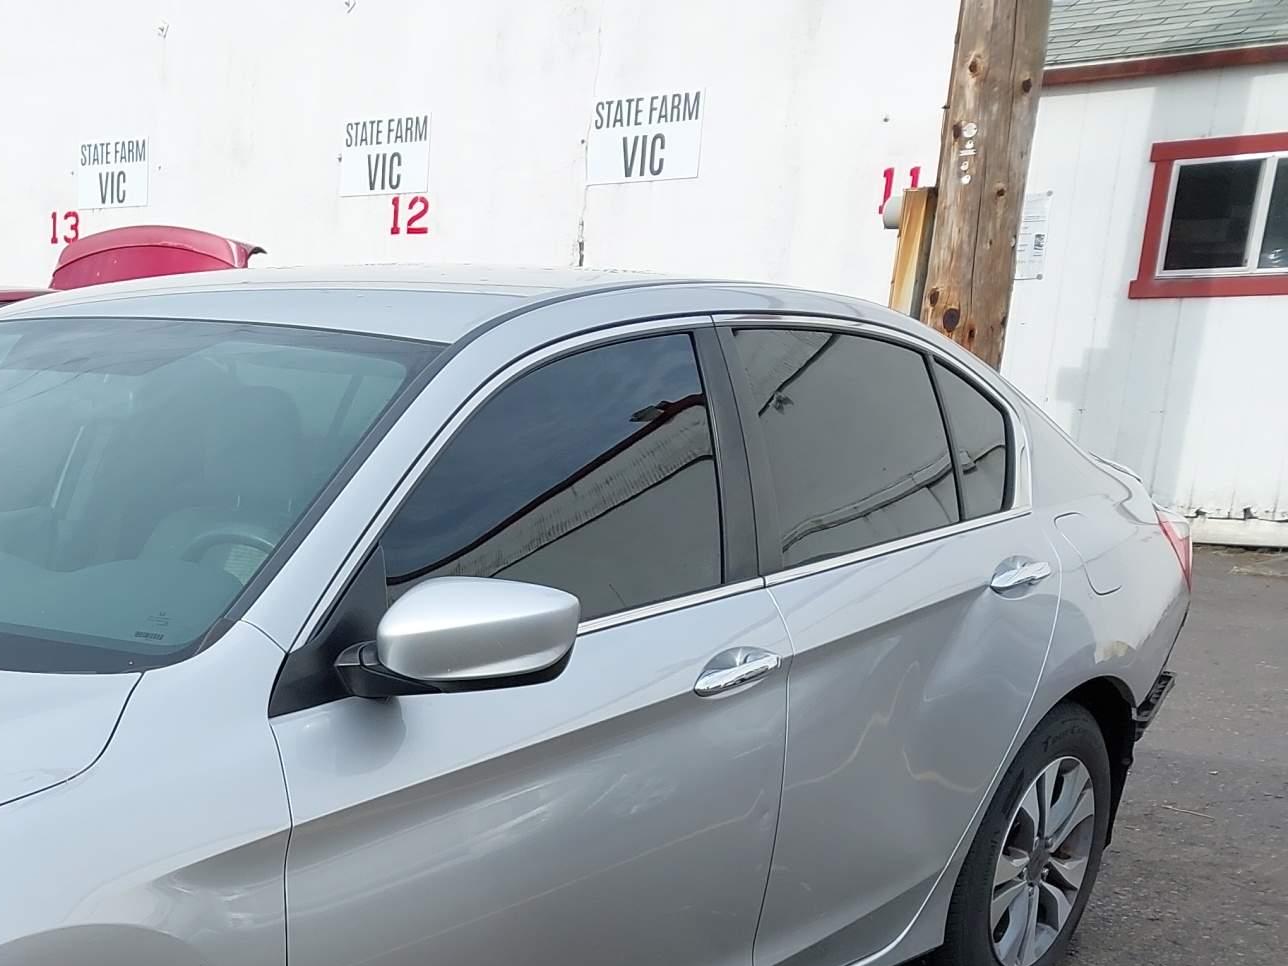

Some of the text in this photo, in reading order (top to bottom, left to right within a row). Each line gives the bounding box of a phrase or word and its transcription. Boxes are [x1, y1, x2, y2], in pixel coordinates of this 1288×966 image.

[595, 91, 701, 130] STATE FARM
[345, 115, 428, 148] STATE FARM
[80, 139, 146, 167] STATE FARM
[367, 152, 402, 191] VIC
[622, 133, 666, 178] VIC
[98, 170, 127, 205] VIC
[50, 210, 80, 245] 13
[390, 195, 430, 235] 12
